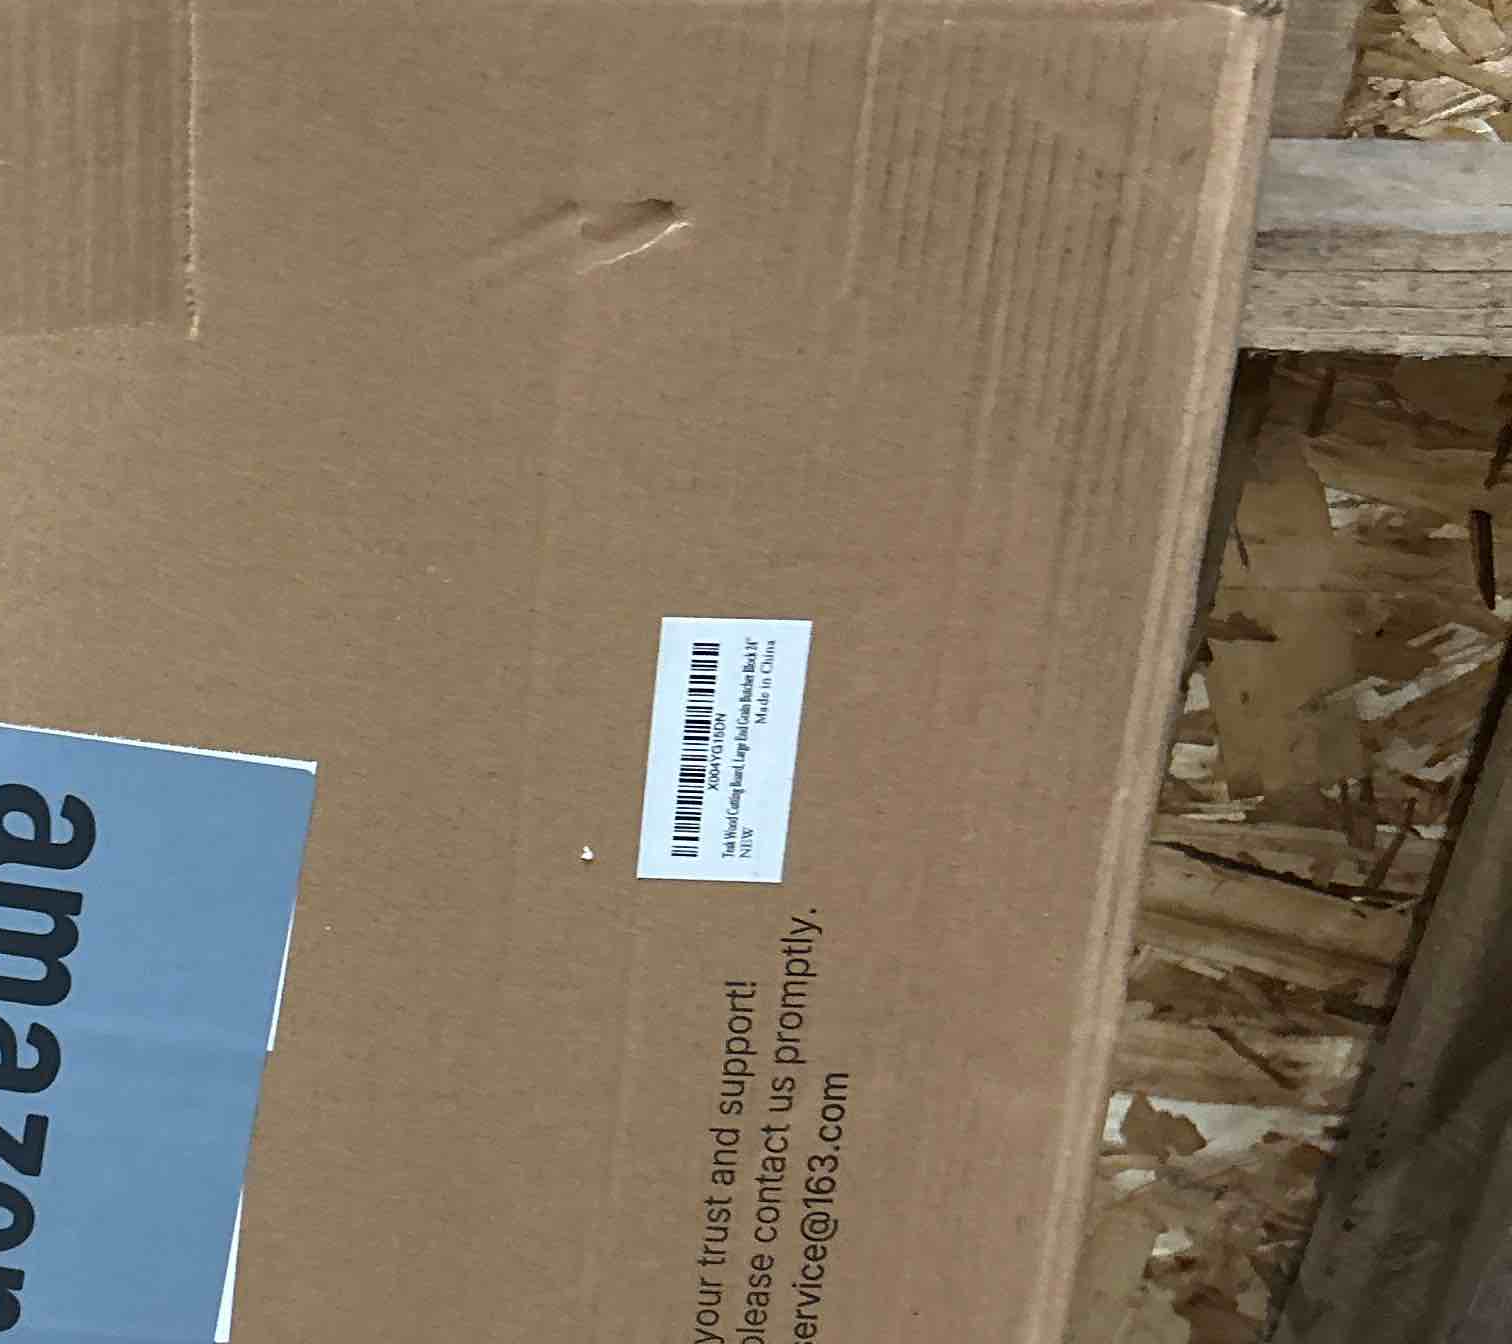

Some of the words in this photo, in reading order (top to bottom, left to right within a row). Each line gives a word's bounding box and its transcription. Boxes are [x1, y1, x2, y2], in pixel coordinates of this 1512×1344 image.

[742, 653, 756, 673] Block
[759, 640, 776, 674] China
[739, 675, 755, 702] Butcher
[759, 677, 773, 689] in
[735, 704, 752, 725] Grain
[755, 691, 770, 724] Made
[734, 726, 749, 741] End
[732, 742, 751, 763] Large
[726, 788, 745, 815] Cutting
[723, 816, 738, 840] Wood
[739, 826, 754, 858] NEW
[774, 907, 823, 1065] promptly.
[720, 980, 757, 1116] support!
[769, 1075, 796, 1113] us
[709, 1127, 740, 1187] and
[754, 1124, 791, 1243] contact
[698, 1196, 732, 1268] trust
